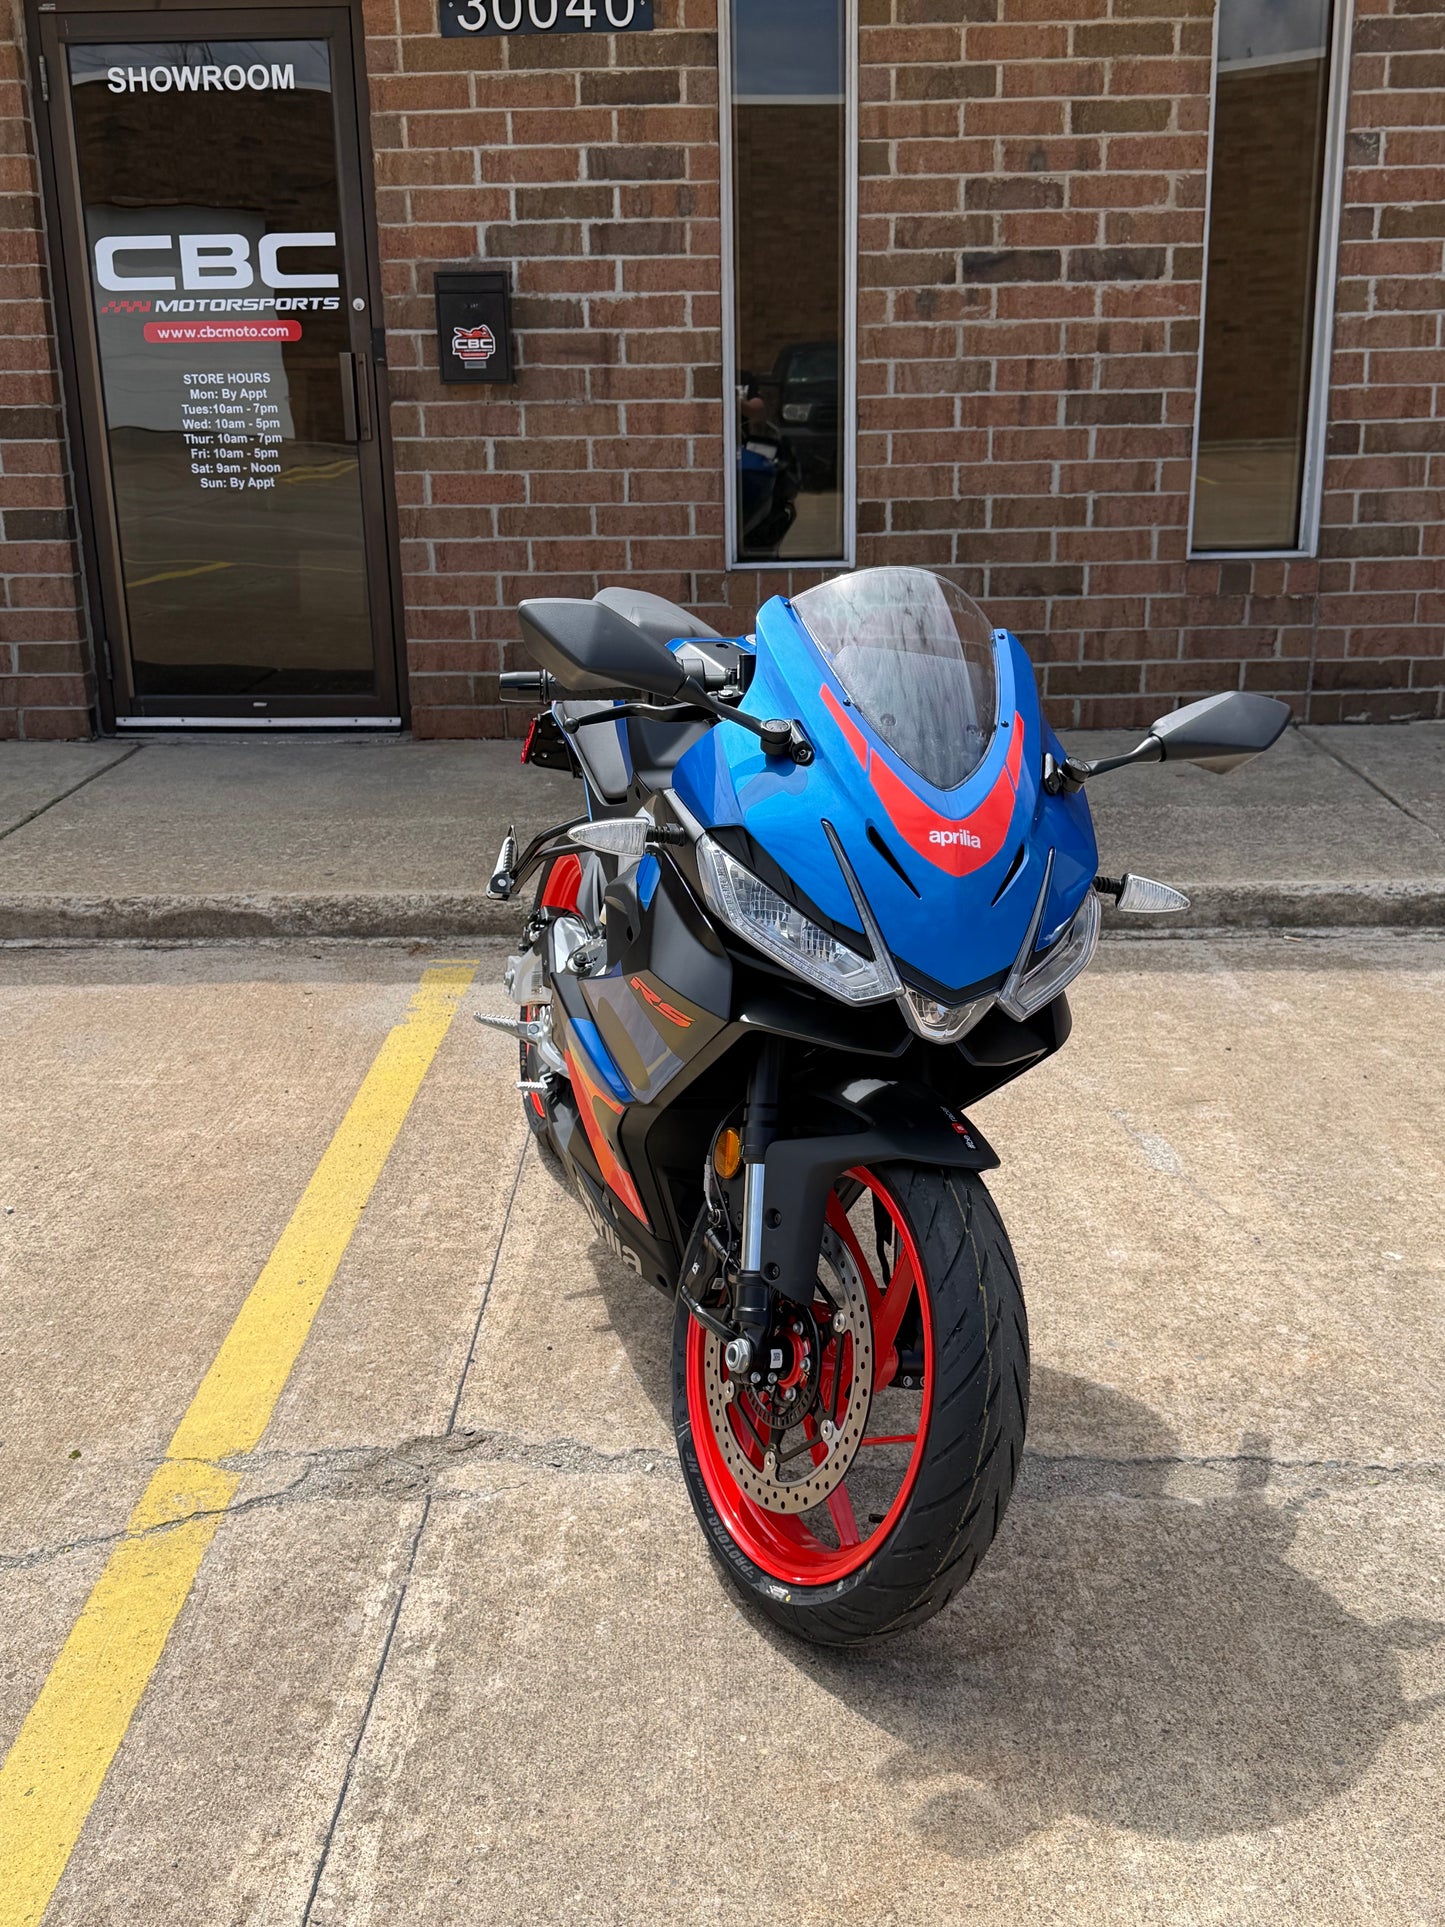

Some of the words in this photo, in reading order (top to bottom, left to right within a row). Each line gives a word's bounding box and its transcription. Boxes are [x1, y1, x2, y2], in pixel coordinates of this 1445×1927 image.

[457, 0, 635, 31] 30040
[107, 64, 295, 93] SHOWROOM
[95, 232, 339, 291] CBC
[155, 297, 340, 312] MOTORSPORTS
[157, 326, 289, 339] www.cbcmoto.com
[454, 339, 492, 349] CBC
[183, 374, 224, 384] STORE
[227, 372, 271, 384] HOURS
[190, 389, 218, 400] Mon:
[222, 388, 236, 401] By
[240, 388, 267, 400] Appt
[253, 403, 278, 415] 7pm
[182, 419, 212, 429] Wed:
[215, 419, 245, 429] 10am
[256, 418, 280, 430] 5pm
[184, 434, 214, 444] Thur:
[218, 434, 248, 444] 10am
[258, 433, 282, 445] 7pm
[191, 449, 210, 459] Fri:
[214, 448, 244, 458] 10am
[254, 448, 278, 460] 5pm
[191, 463, 214, 474] Sat:
[216, 463, 240, 473] 9am
[250, 462, 281, 473] Noon
[201, 478, 226, 488] Sun:
[230, 477, 245, 490] By
[248, 477, 275, 490] Appt
[929, 829, 981, 848] aprilia
[630, 976, 696, 1028] RS
